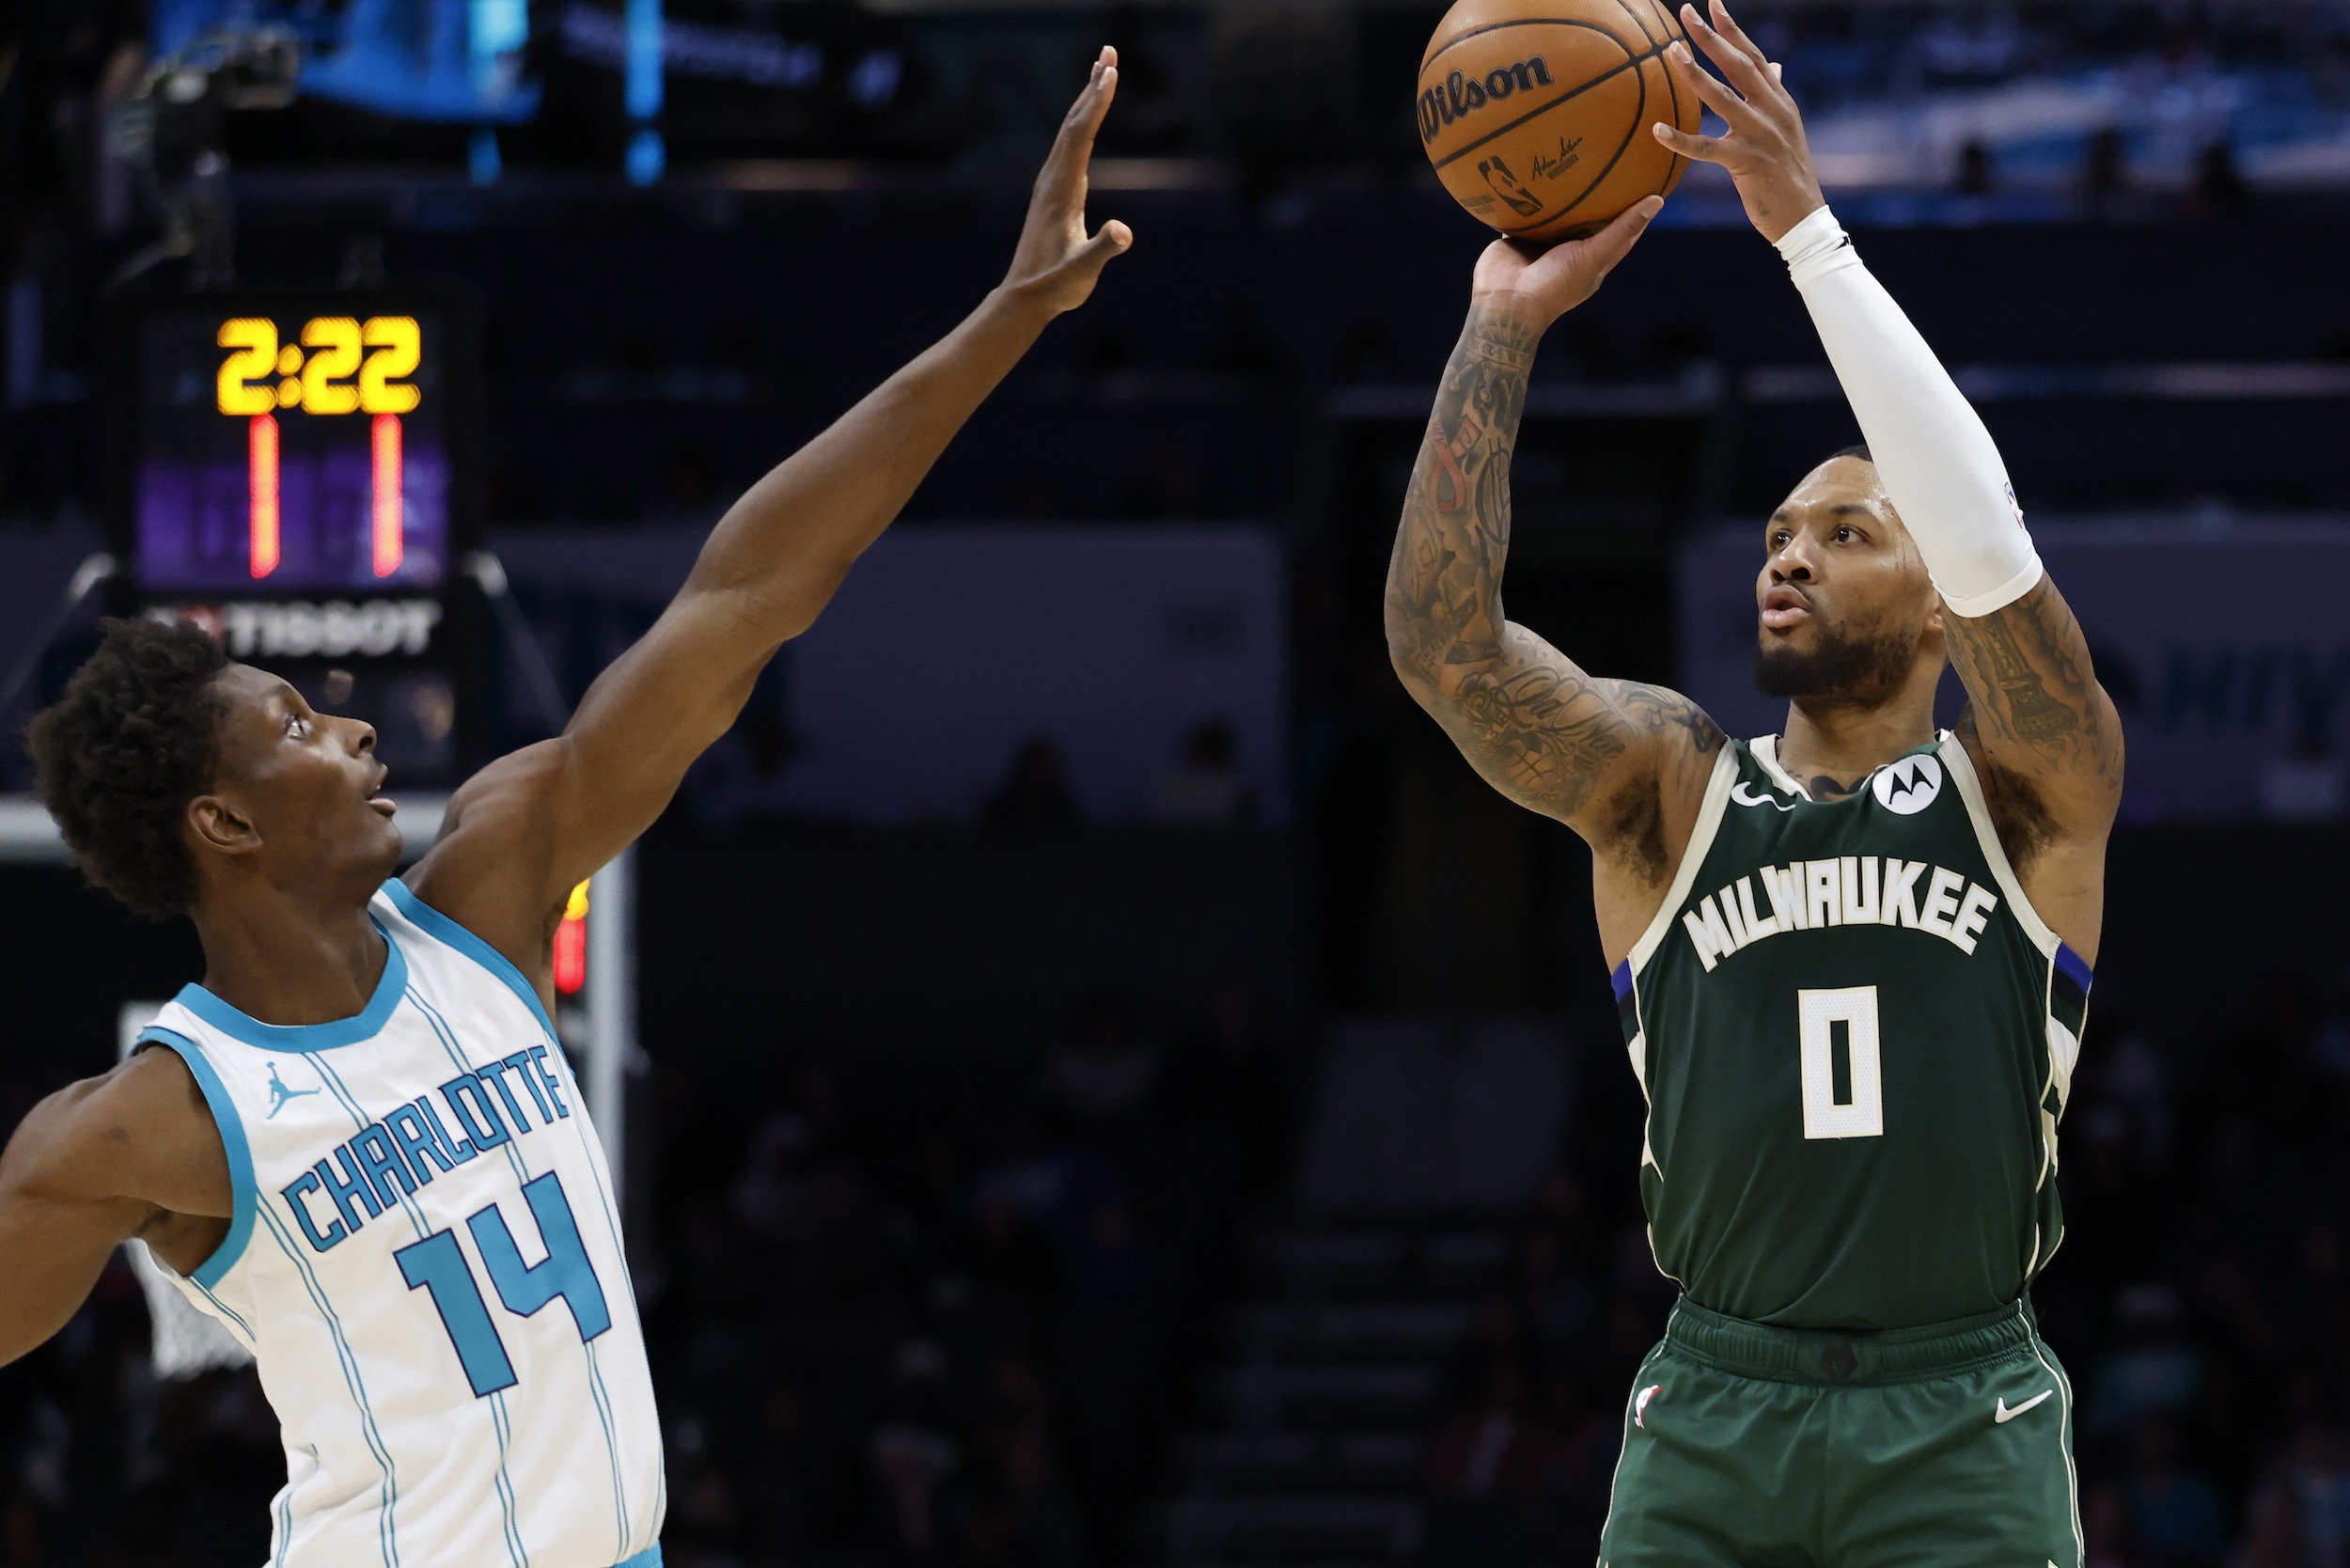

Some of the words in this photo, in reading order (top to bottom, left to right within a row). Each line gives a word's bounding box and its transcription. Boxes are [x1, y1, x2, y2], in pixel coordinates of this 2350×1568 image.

[217, 315, 421, 416] 2:22
[227, 600, 441, 657] TISSOT
[1682, 856, 1998, 974] MILWAUKEE
[1797, 985, 1884, 1140] 0
[279, 1045, 570, 1253] CHARLOTTE
[393, 1169, 612, 1399] 14
